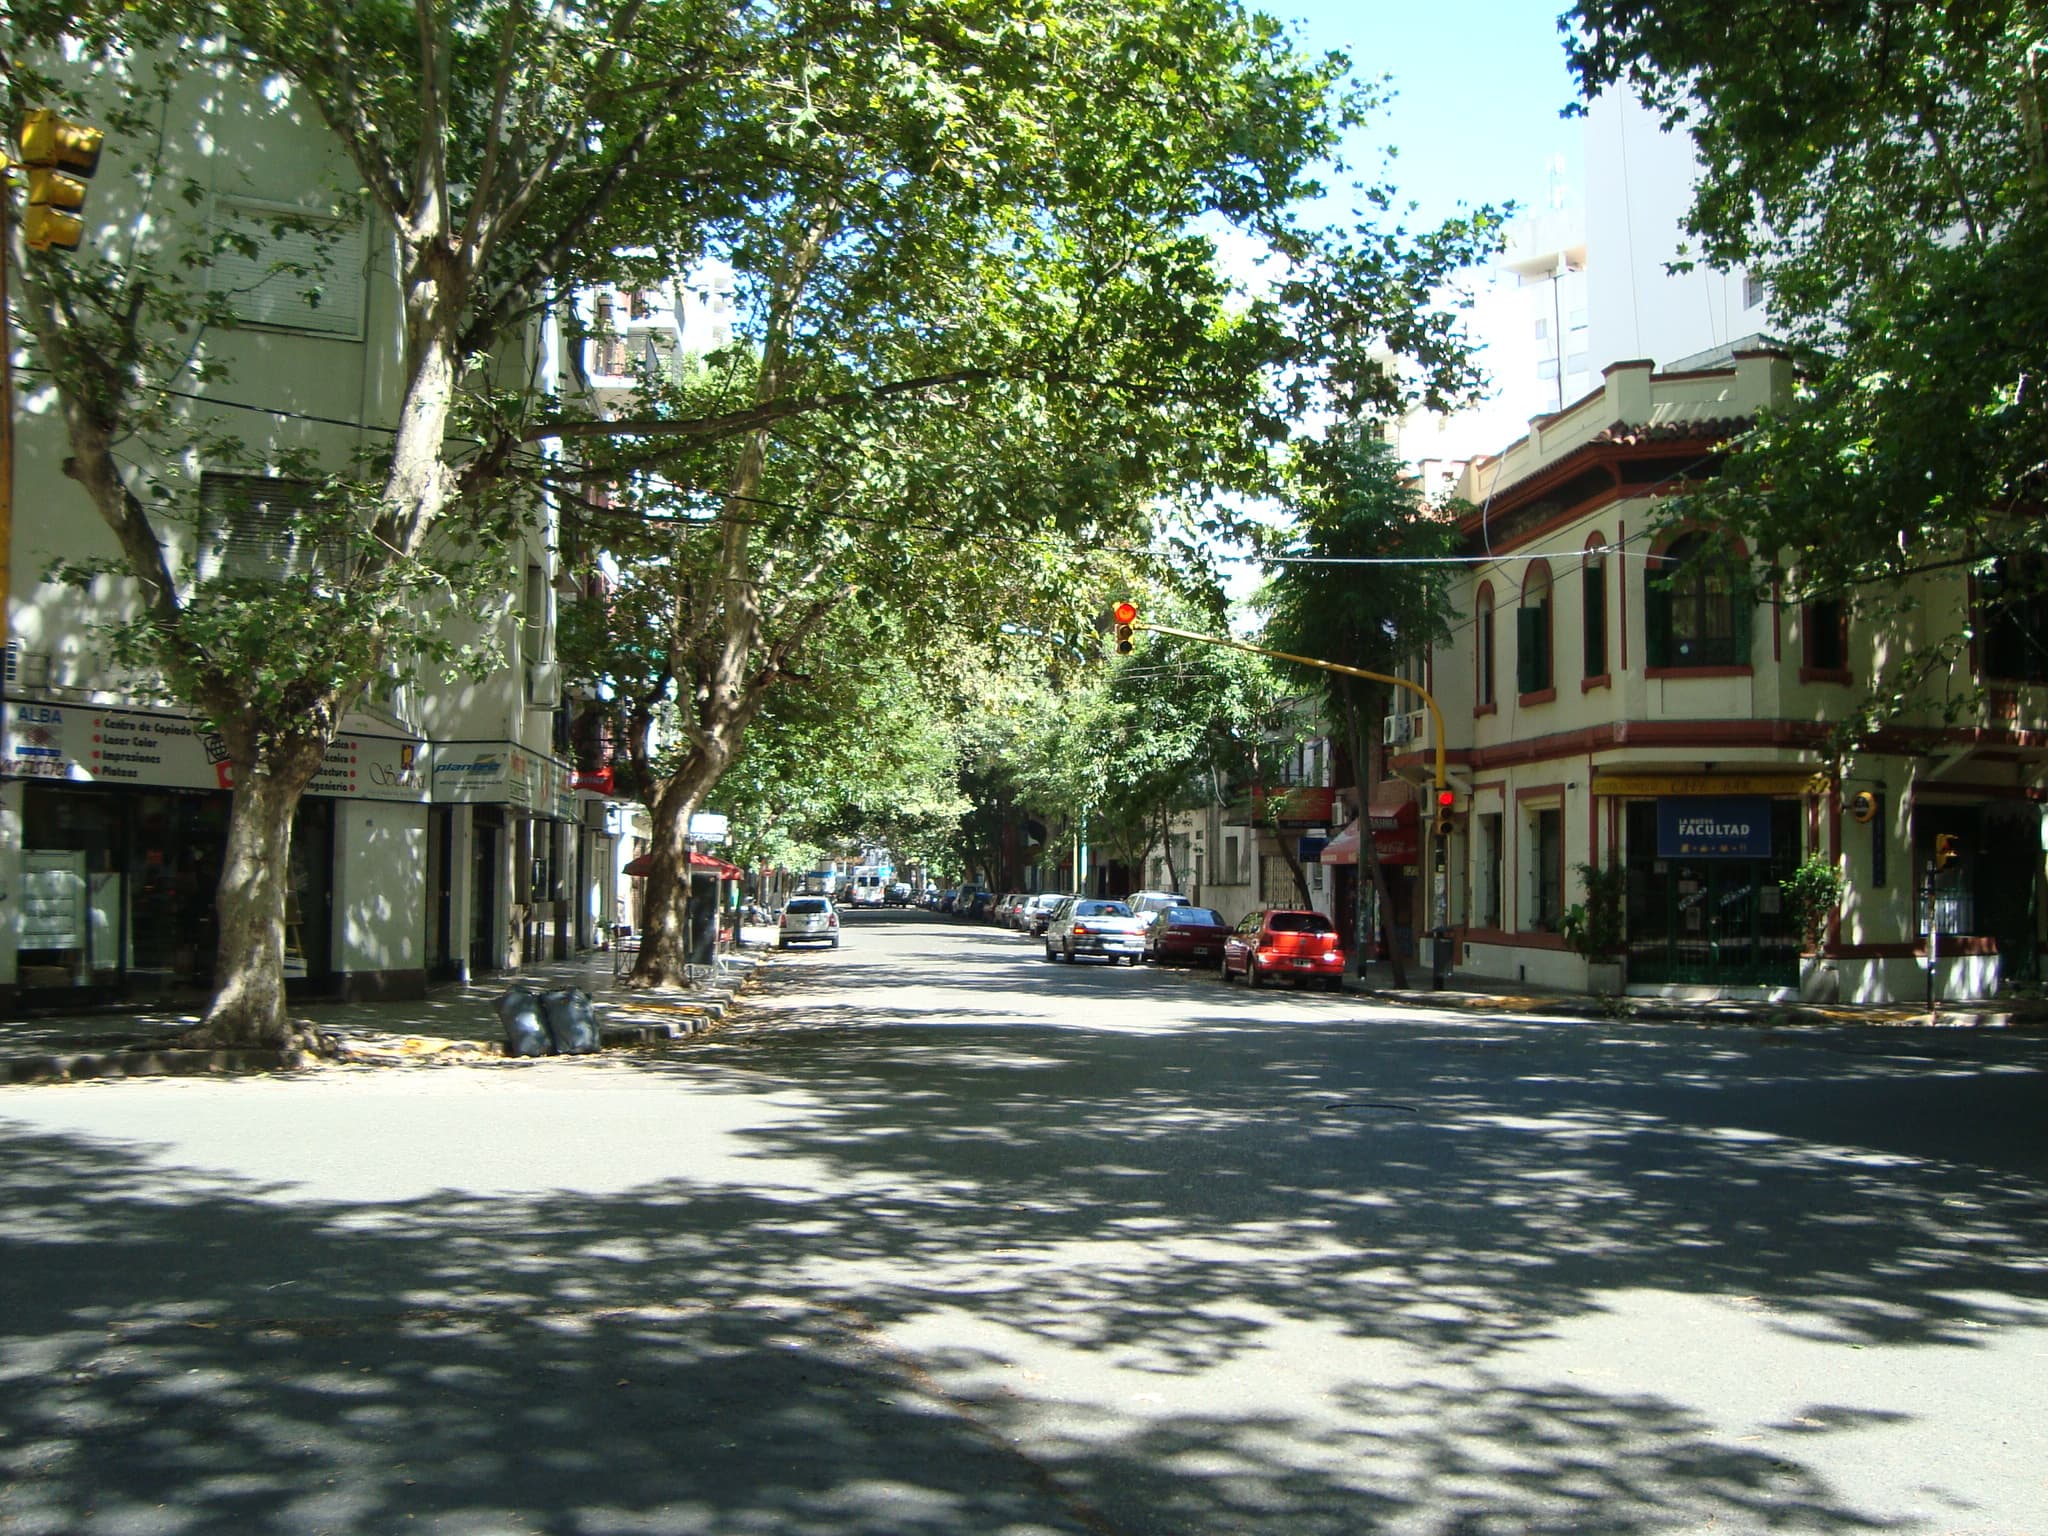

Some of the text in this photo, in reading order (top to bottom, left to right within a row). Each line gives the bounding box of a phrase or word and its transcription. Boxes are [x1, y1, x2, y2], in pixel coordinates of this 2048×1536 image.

[19, 705, 63, 724] ALBA
[104, 717, 192, 736] Centro de Copiado
[133, 736, 158, 748] Color
[102, 749, 161, 764] Impresiones
[1679, 824, 1750, 836] FACULTAD
